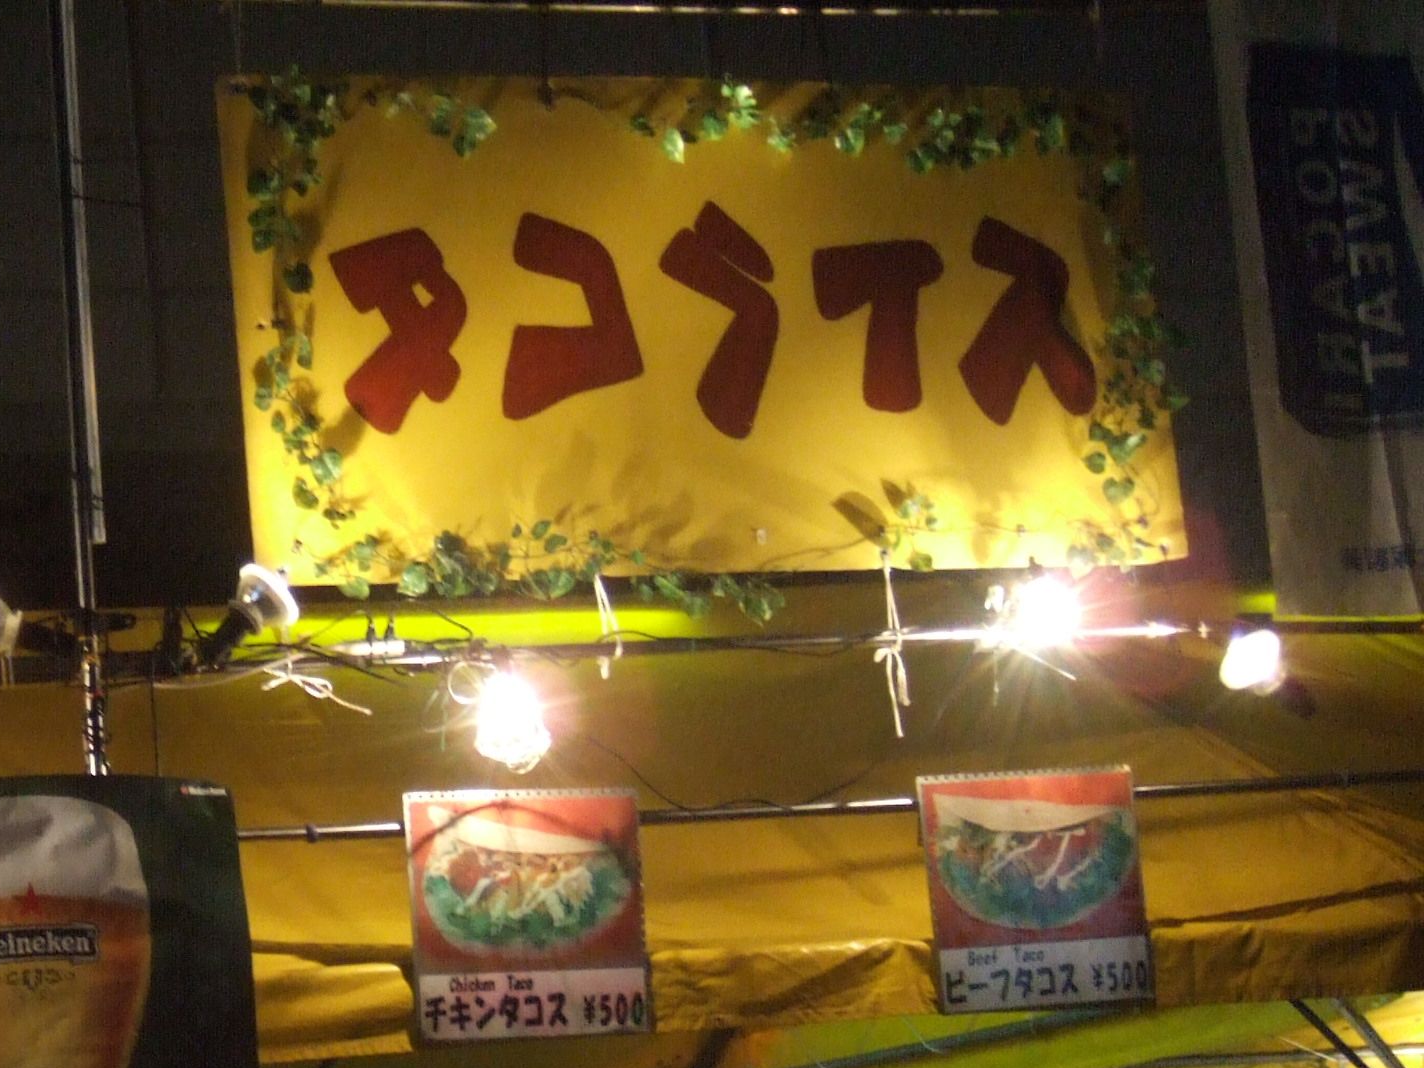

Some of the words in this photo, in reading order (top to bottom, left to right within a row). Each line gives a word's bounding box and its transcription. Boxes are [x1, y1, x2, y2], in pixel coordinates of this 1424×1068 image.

[328, 200, 1098, 440] タコライス
[449, 975, 496, 993] Chicken
[507, 974, 534, 992] Taco
[1090, 959, 1148, 993] ¥500
[425, 992, 569, 1033] チキンタコス
[583, 991, 644, 1027] ¥500
